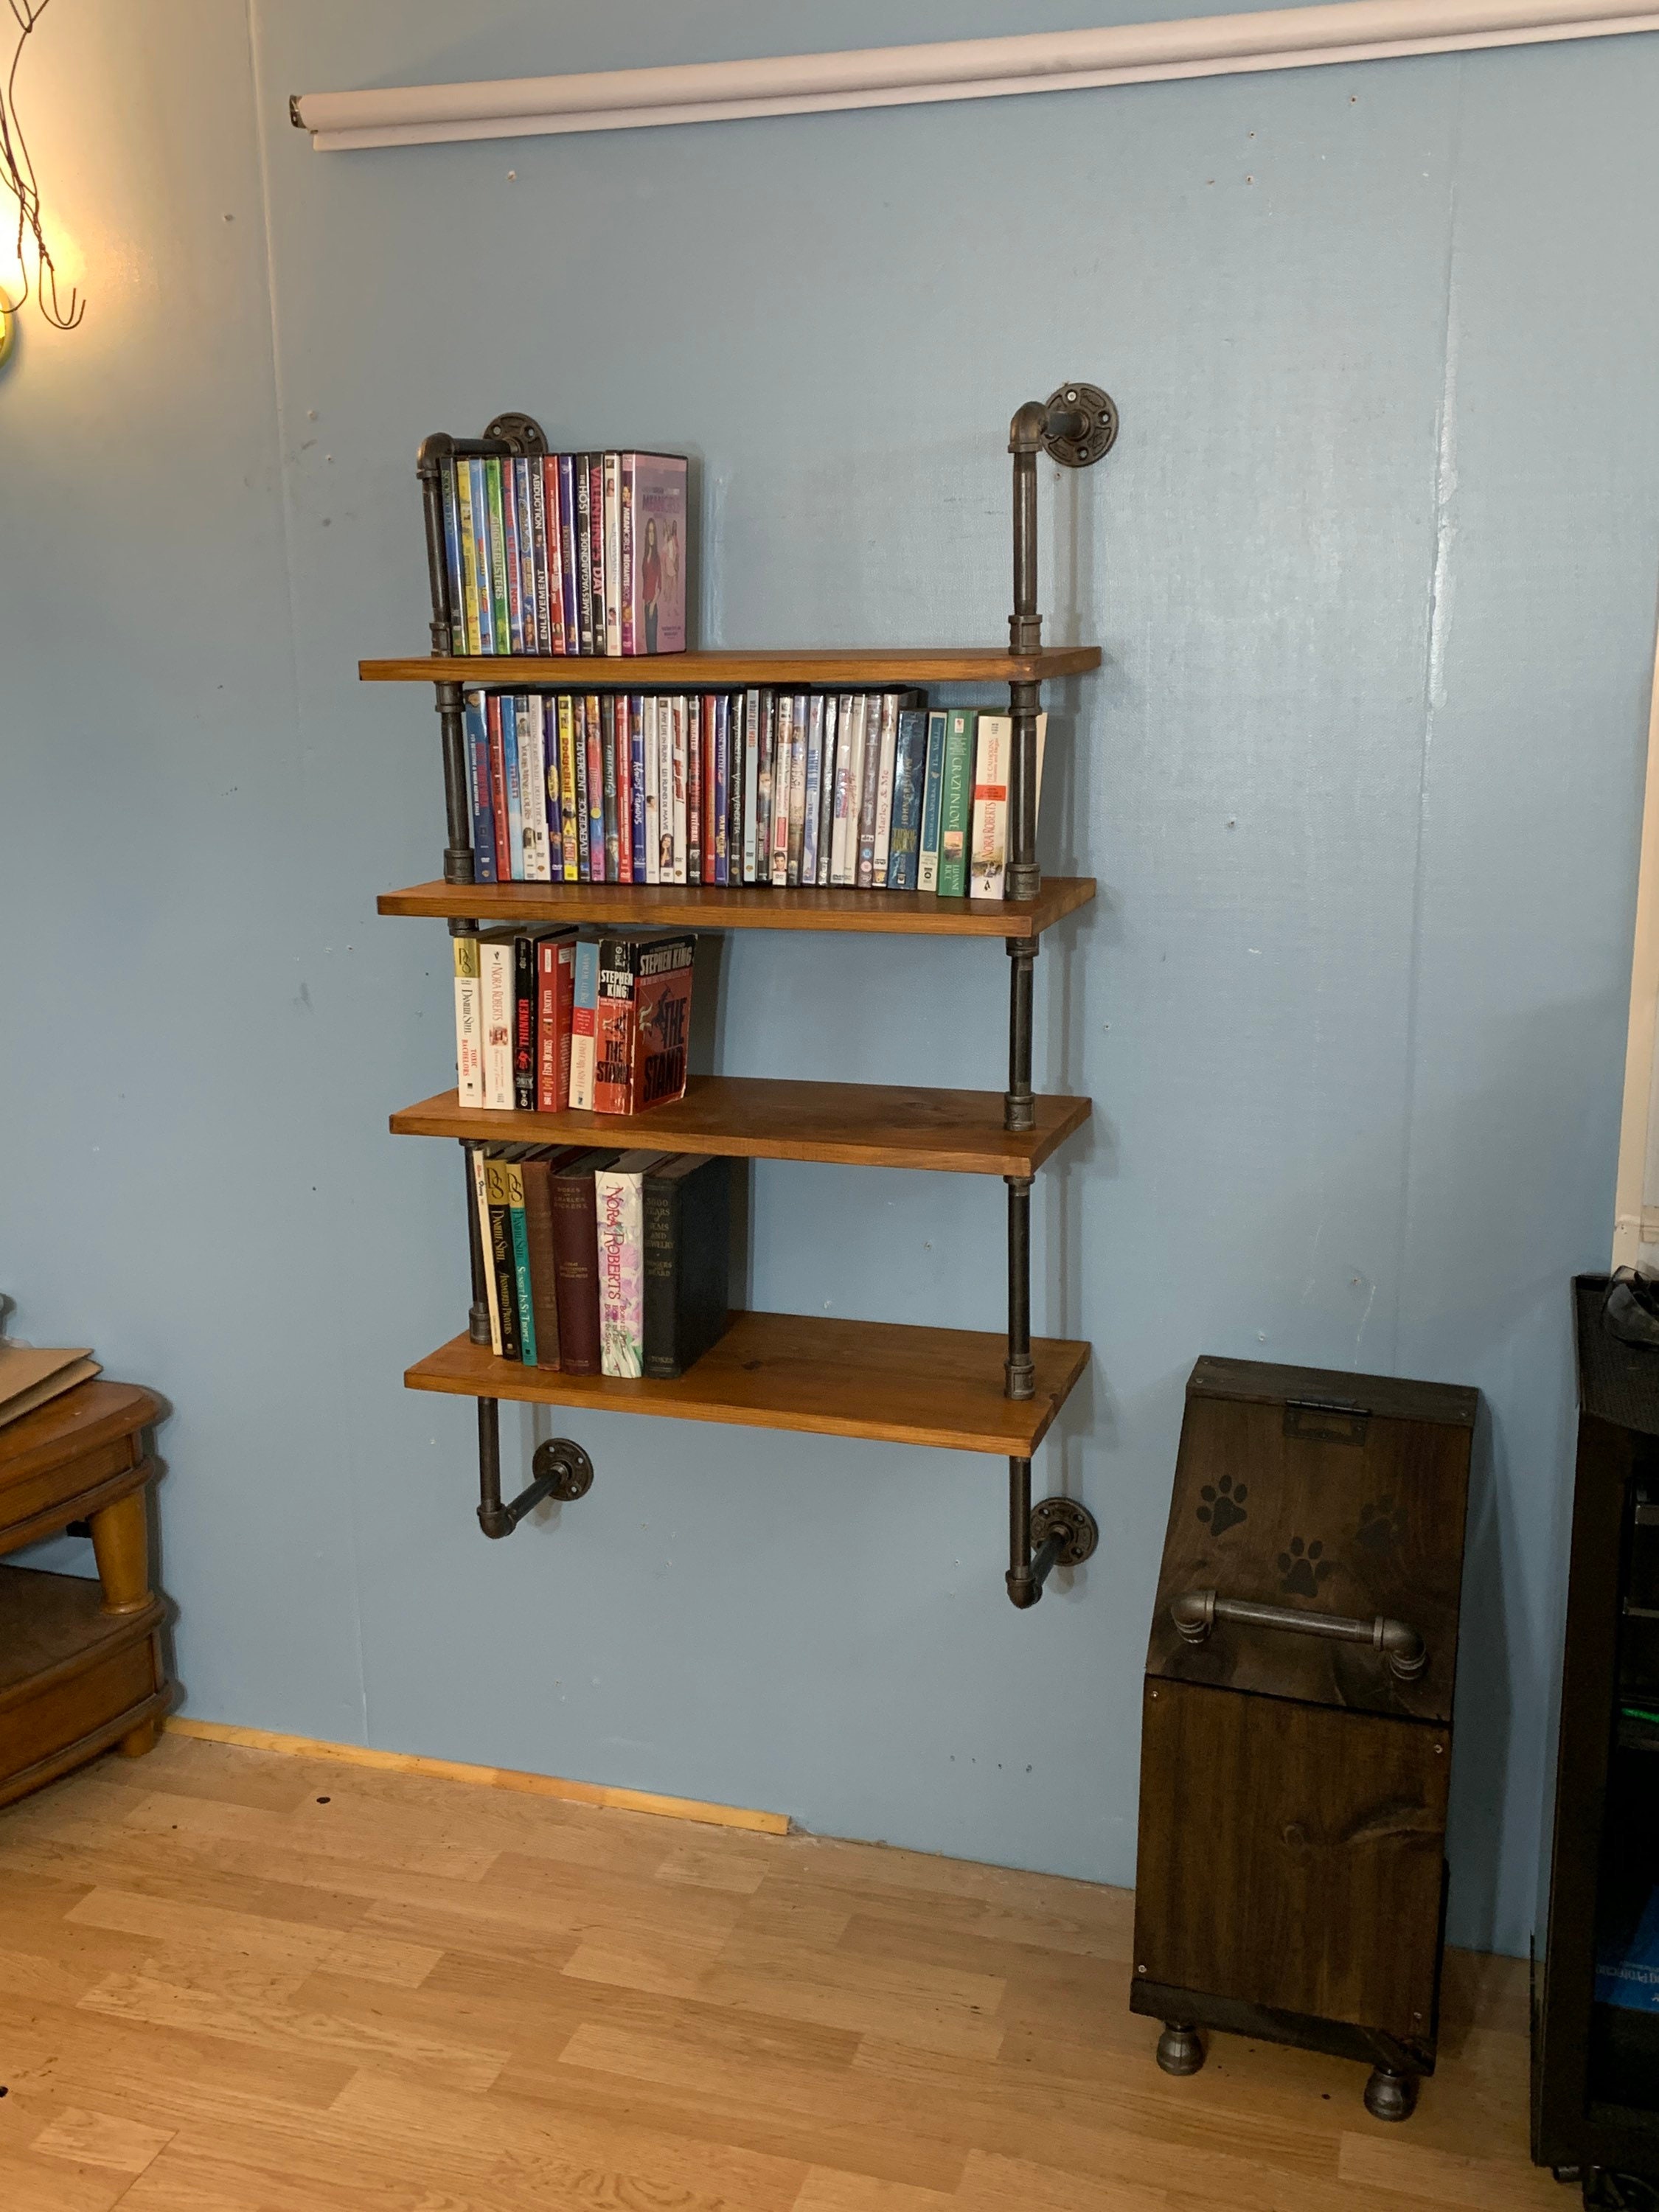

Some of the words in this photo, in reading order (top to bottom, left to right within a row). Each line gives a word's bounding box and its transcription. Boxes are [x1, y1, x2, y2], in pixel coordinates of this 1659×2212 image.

[532, 473, 542, 529] ABDUCTION
[579, 486, 588, 515] HOST
[591, 466, 602, 561] VALENTINE'S
[492, 516, 503, 599] GHOSTBUSTERS
[580, 532, 588, 591] VAGABONDES
[593, 567, 602, 597] DAY
[537, 569, 548, 640] ENLÈVEMENT
[748, 719, 757, 729] girl
[562, 737, 570, 793] DodgeBall
[577, 742, 585, 793] DIVERGENT
[633, 762, 643, 792] Almost
[731, 773, 740, 781] V
[880, 770, 889, 782] Me
[952, 757, 963, 791] CRAZY
[880, 786, 887, 798] &
[951, 793, 962, 804] IN
[634, 793, 643, 825] Famous
[731, 796, 741, 835] VENDETTA
[877, 801, 888, 835] Marley
[949, 805, 962, 830] LOVE
[983, 802, 997, 834] ROBERTS
[691, 812, 699, 842] INTÉGRAL
[981, 834, 994, 858] NORA
[945, 864, 953, 880] RICE
[640, 948, 672, 975] STEPHEN
[672, 946, 692, 967] KING
[492, 967, 503, 989] NORA
[601, 970, 633, 986] STEPHEN
[607, 984, 629, 998] KING
[462, 990, 473, 1015] DANIELLE
[492, 991, 504, 1020] ROBERTS
[463, 1016, 474, 1034] STEEL
[519, 998, 529, 1048] THINNER
[664, 997, 687, 1048] THE
[462, 1039, 470, 1076] BACHELORS
[605, 1040, 624, 1062] THE
[543, 1062, 552, 1075] FERN
[575, 1071, 585, 1088] FERN
[597, 1061, 628, 1085] STAND
[605, 1186, 625, 1228] NORA
[490, 1210, 504, 1240] DANIELLE
[512, 1211, 523, 1239] DANIELLE
[493, 1241, 506, 1262] STEEL
[603, 1231, 625, 1300] ROBERTS
[499, 1271, 510, 1307] ANSWERED
[517, 1266, 526, 1293] SUNSET
[520, 1295, 527, 1303] IN
[503, 1307, 514, 1335] PRAYERS
[521, 1316, 530, 1343] TROPEZ
